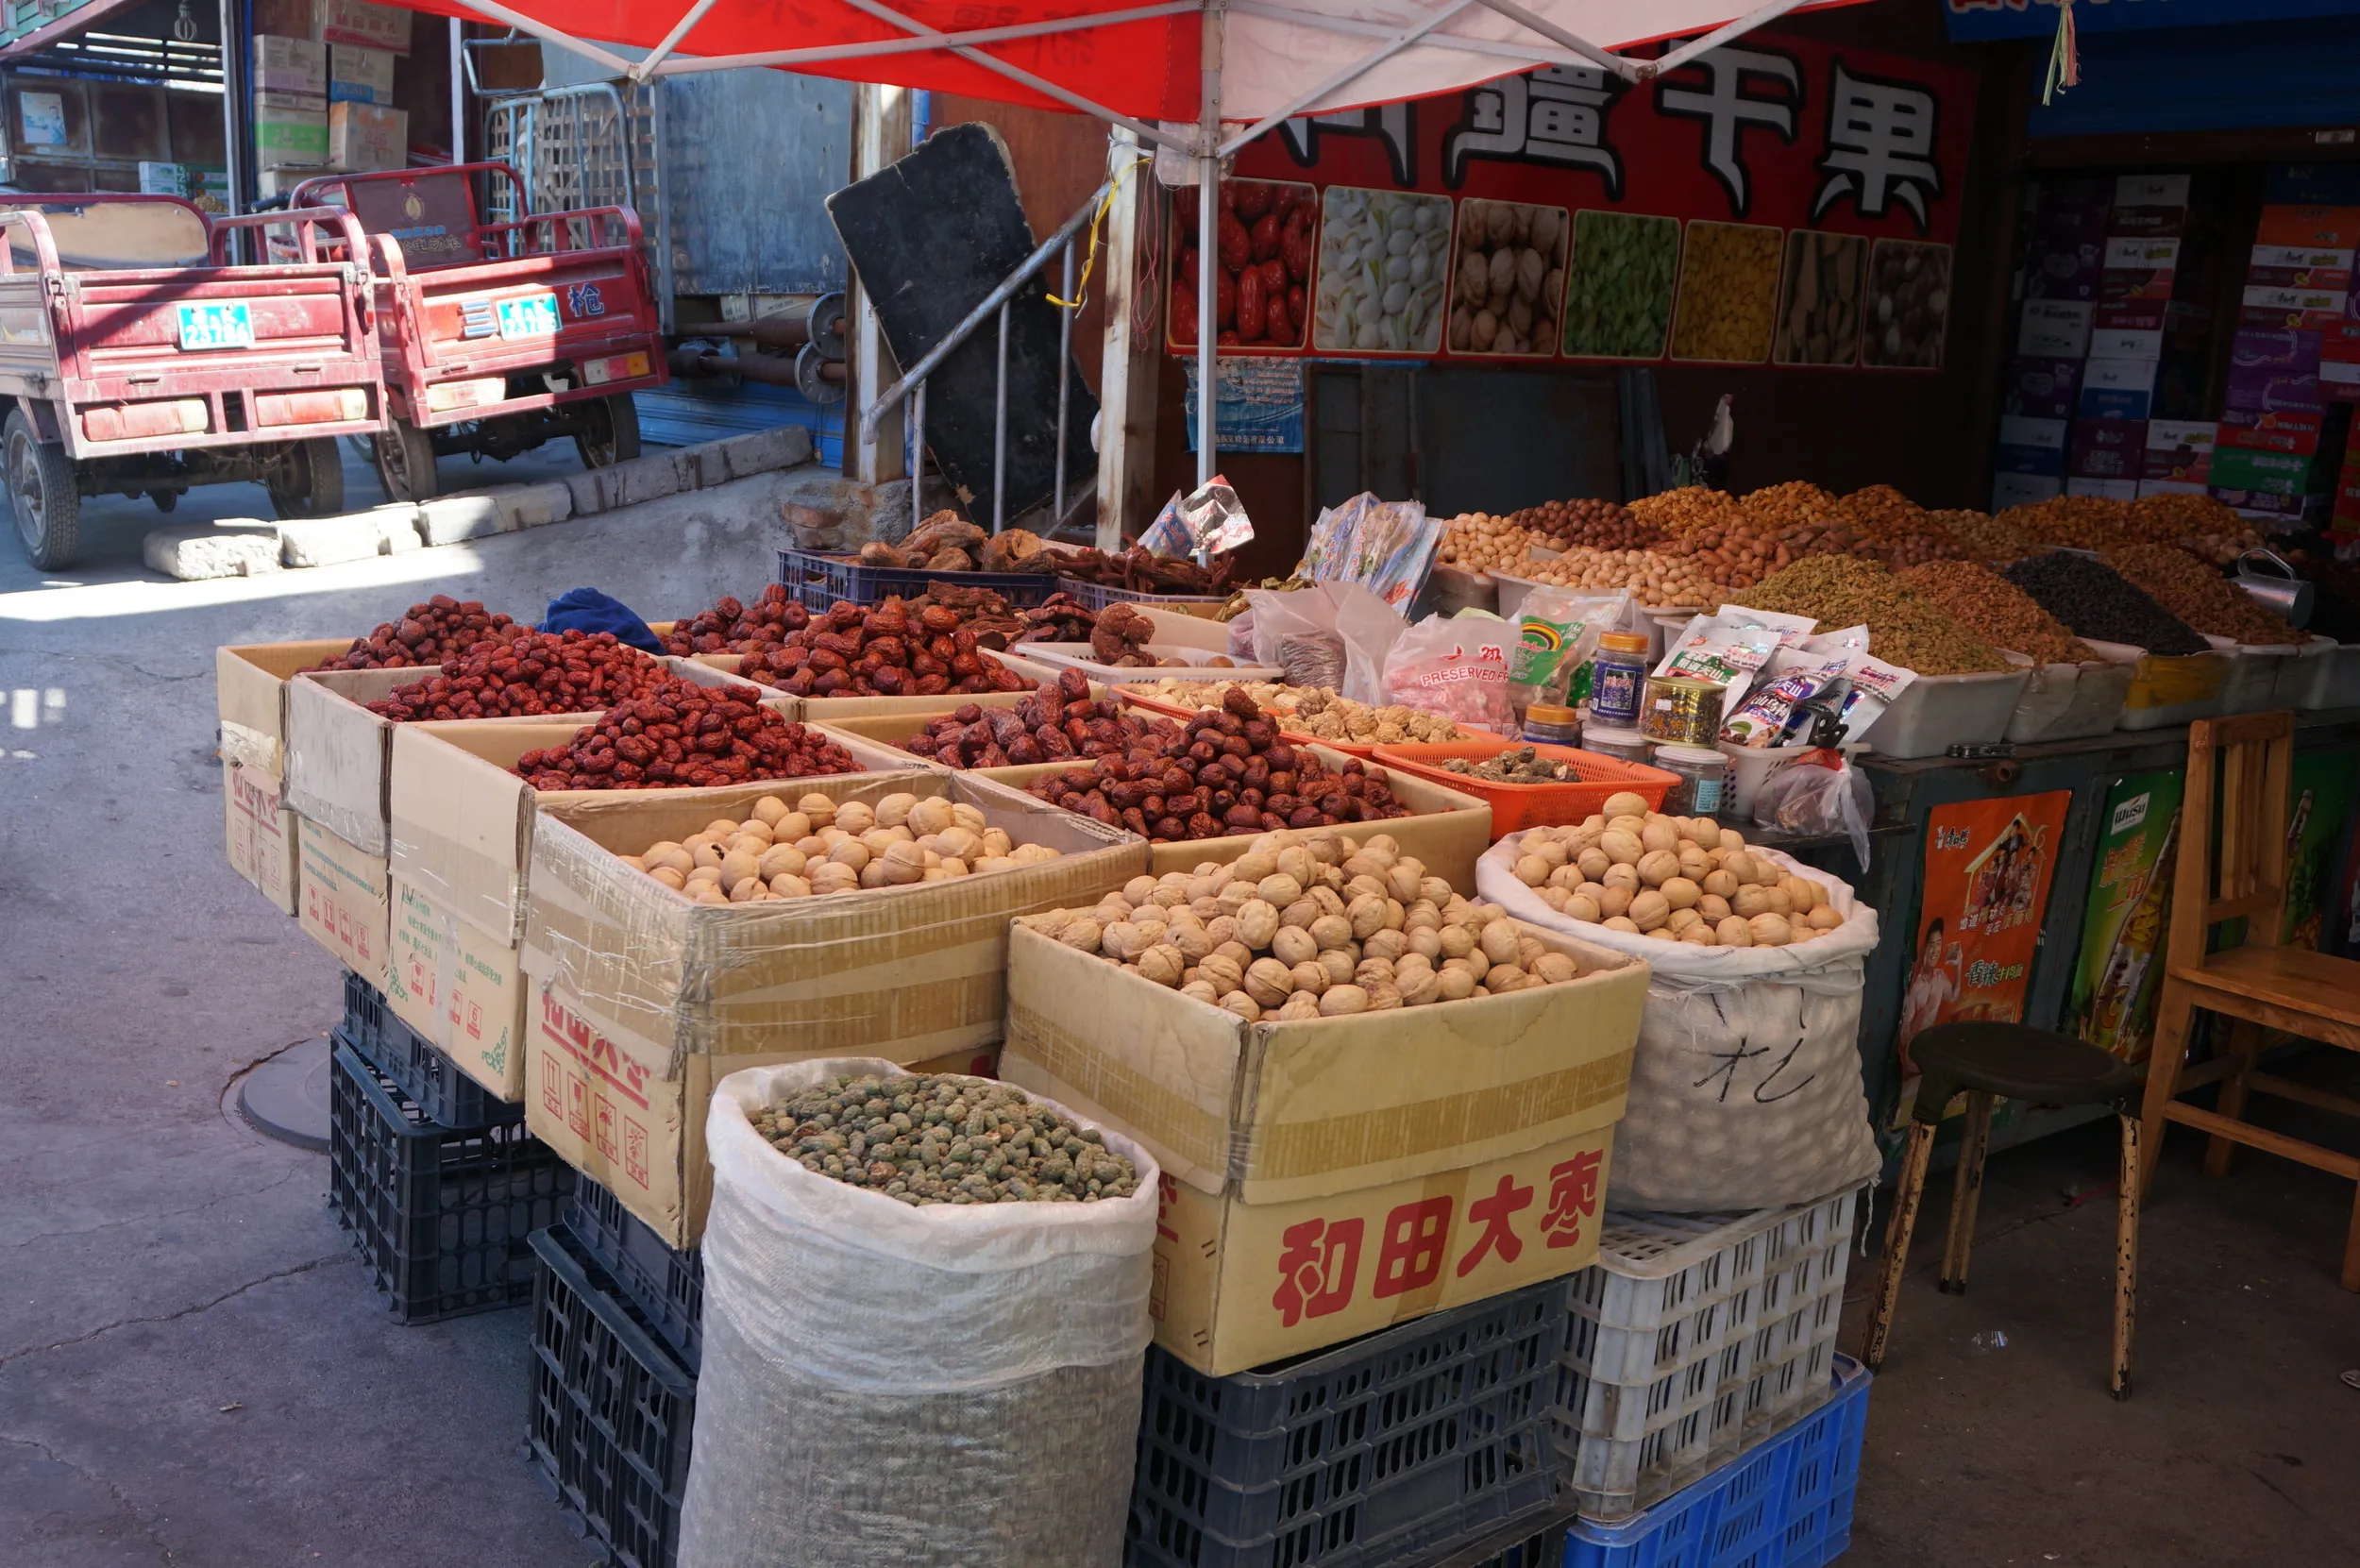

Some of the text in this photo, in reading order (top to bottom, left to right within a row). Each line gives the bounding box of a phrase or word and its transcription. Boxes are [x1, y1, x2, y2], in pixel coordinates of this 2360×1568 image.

[1276, 38, 1939, 225] 疆干果
[1421, 666, 1495, 686] PRESERVED
[1273, 1149, 1603, 1327] 和田大枣
